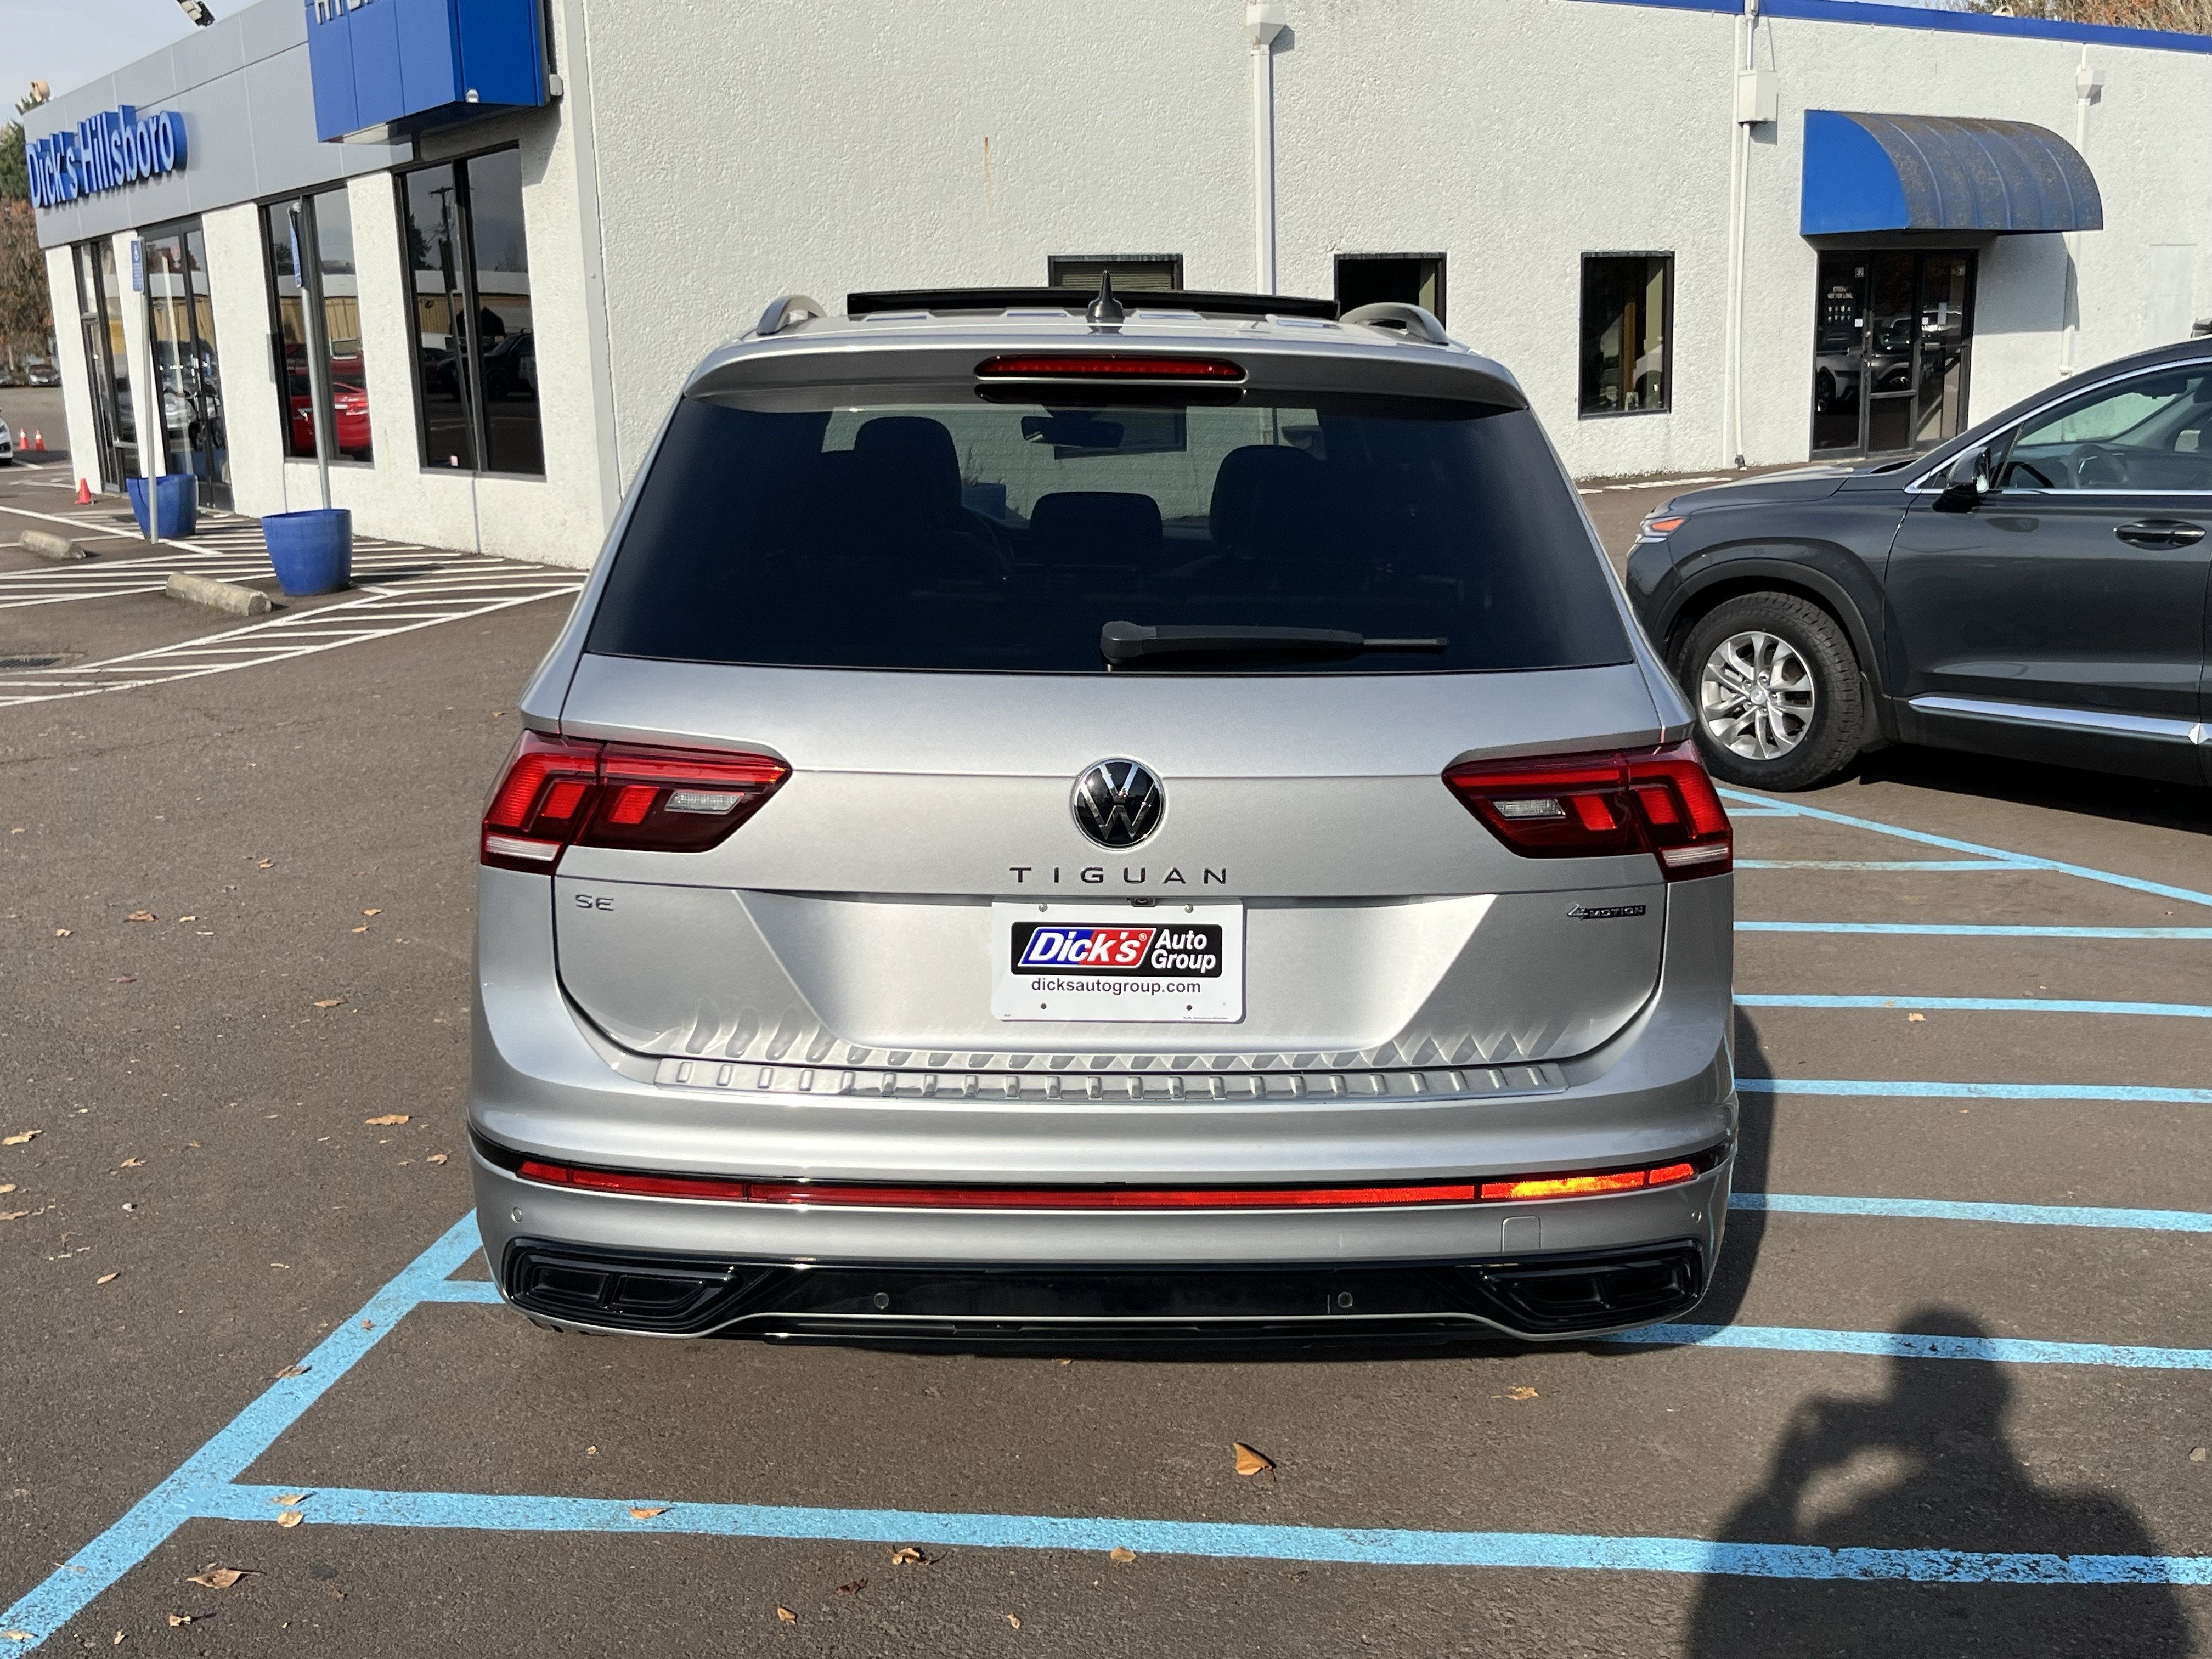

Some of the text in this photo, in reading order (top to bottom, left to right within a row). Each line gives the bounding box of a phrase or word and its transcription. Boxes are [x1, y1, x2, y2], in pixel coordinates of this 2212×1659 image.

[26, 104, 176, 209] Dick's Hillsboro
[1009, 866, 1227, 884] TIGUAN
[575, 894, 614, 911] SE
[1028, 931, 1140, 962] Dick's
[1155, 929, 1207, 949] Auto
[1151, 949, 1216, 973] Group
[1031, 978, 1201, 995] dicksautogroup.com
